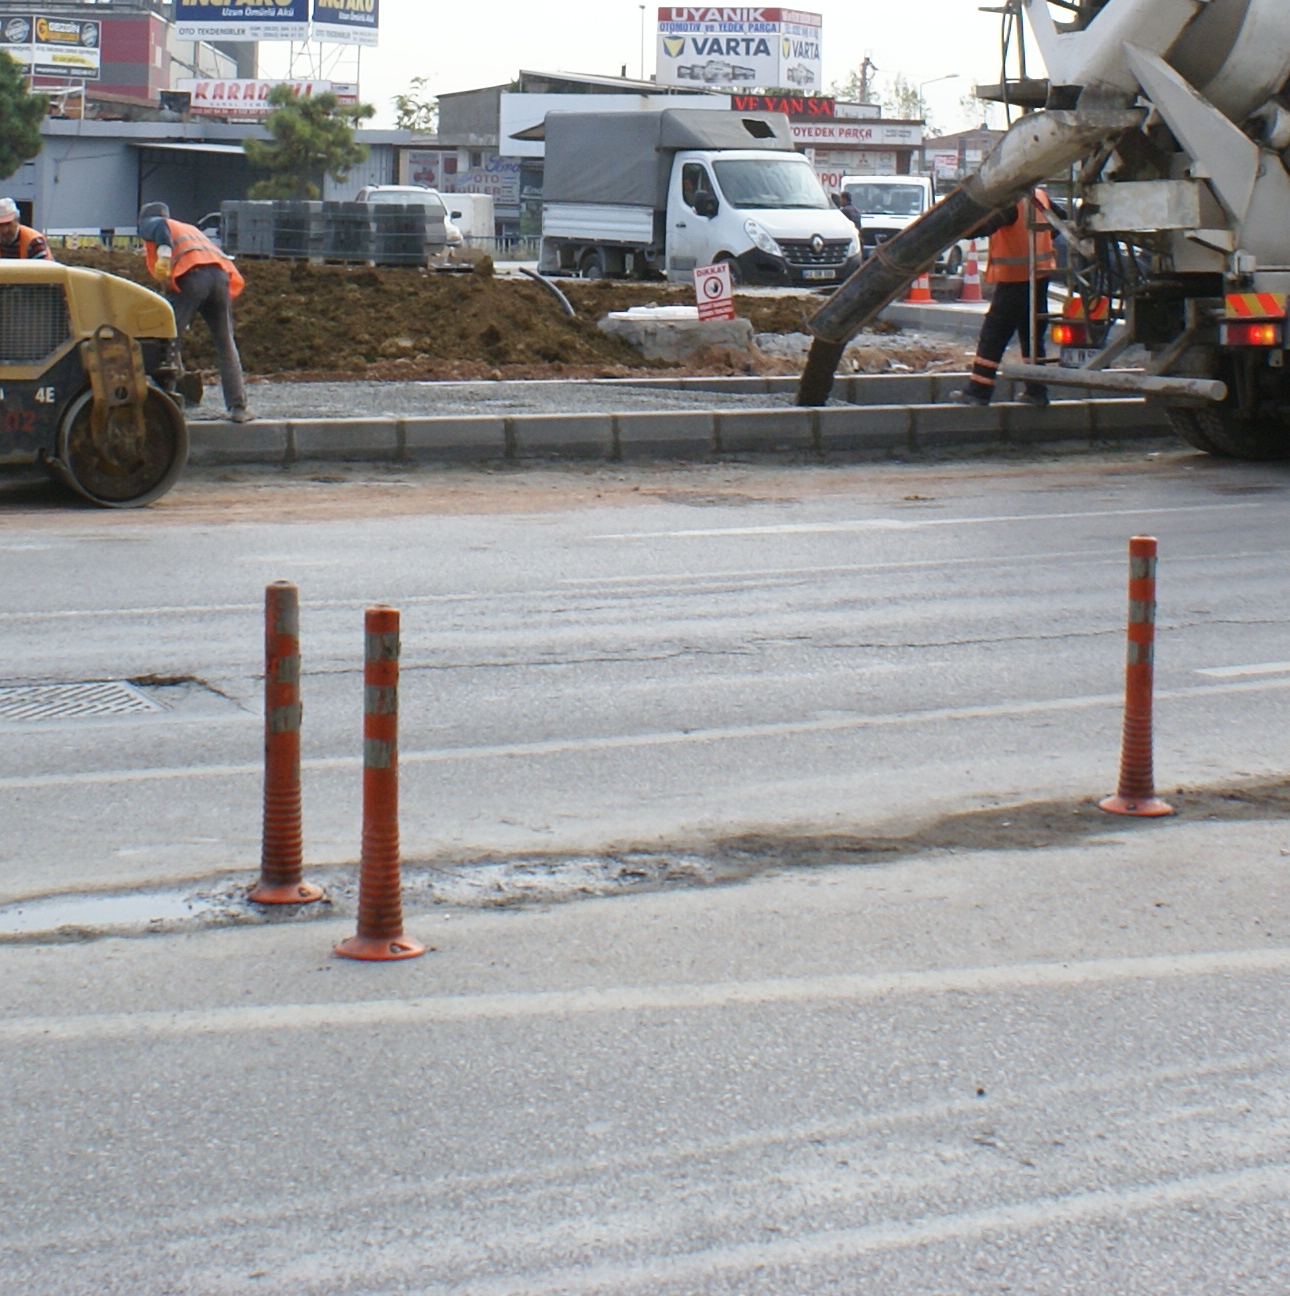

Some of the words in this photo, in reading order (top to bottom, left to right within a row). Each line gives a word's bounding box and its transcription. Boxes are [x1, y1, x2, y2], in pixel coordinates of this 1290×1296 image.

[671, 7, 766, 21] UYANIK
[718, 23, 745, 33] YEDEK
[748, 23, 777, 33] PARÇA
[691, 37, 771, 56] VARTA
[791, 40, 820, 59] VARTA
[764, 96, 803, 115] YAN
[838, 127, 873, 141] PARÇA
